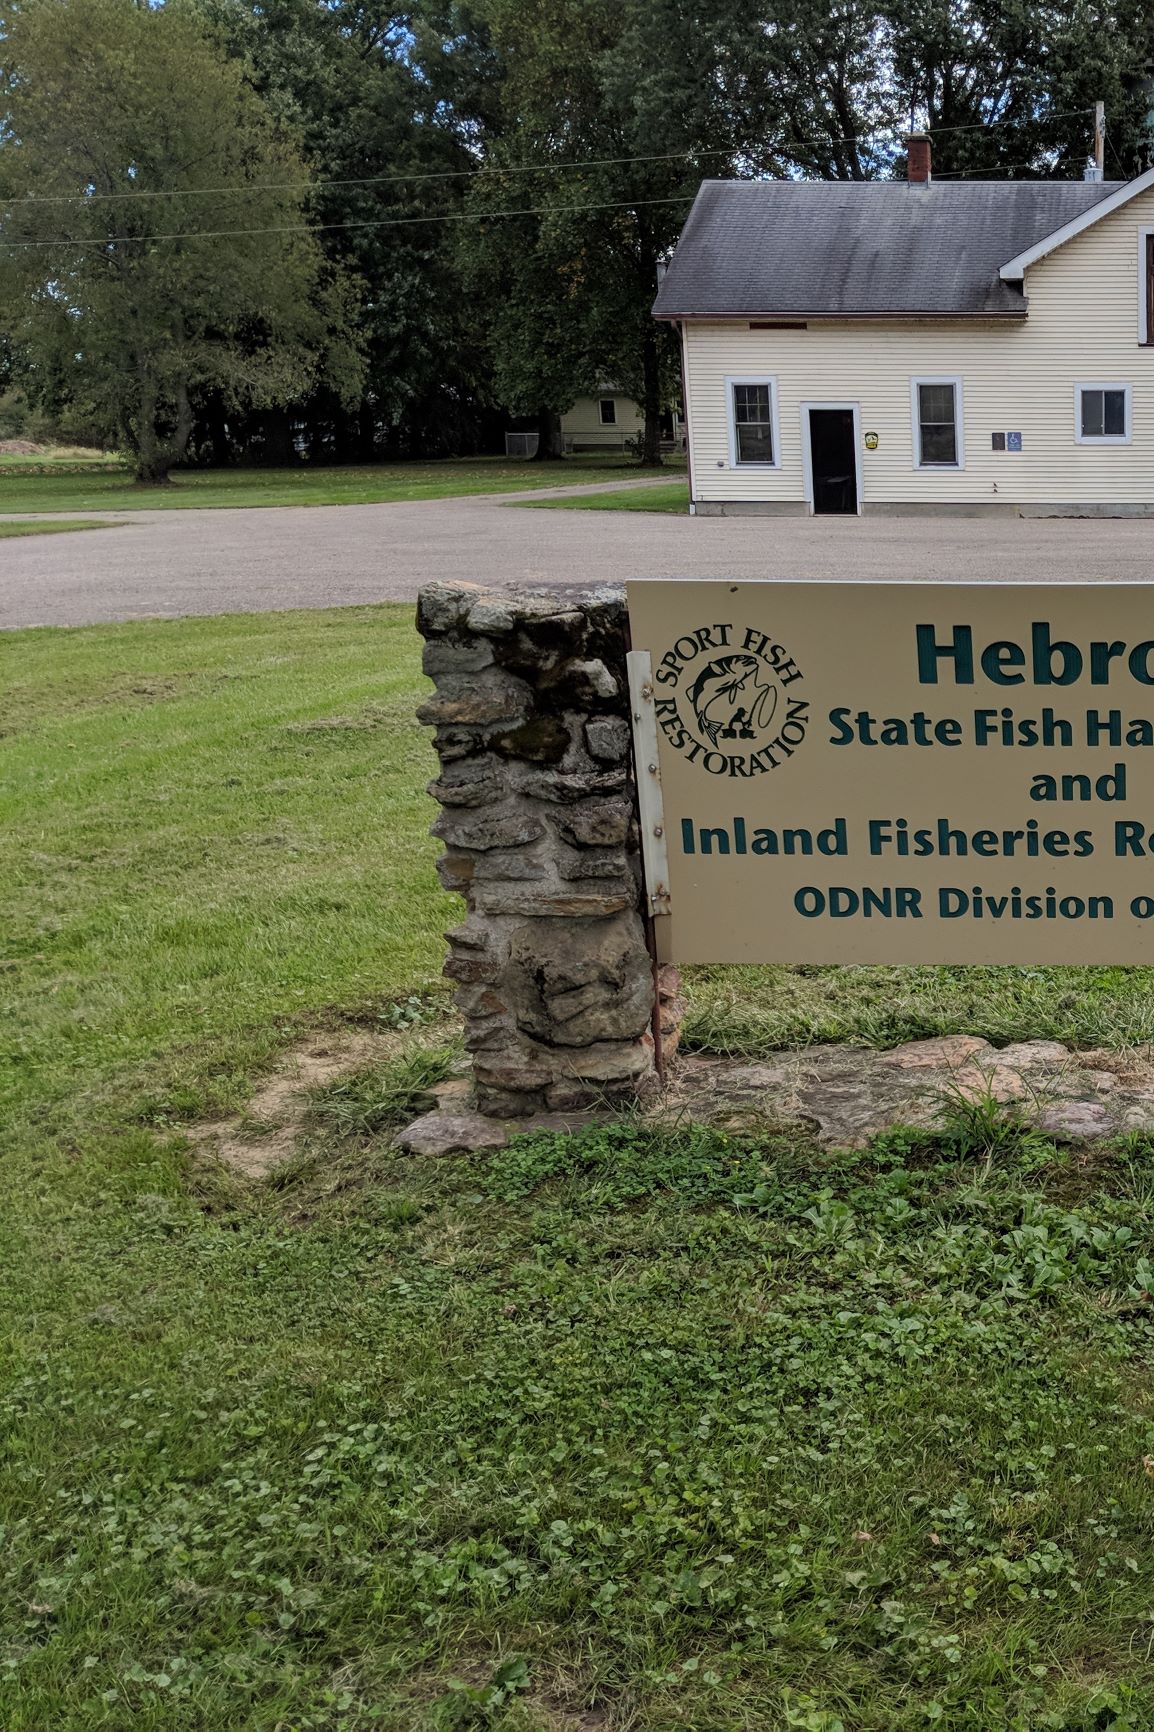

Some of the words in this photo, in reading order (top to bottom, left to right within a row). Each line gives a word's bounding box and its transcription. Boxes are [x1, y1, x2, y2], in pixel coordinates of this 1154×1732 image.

[656, 623, 733, 688] SPORT
[741, 627, 804, 687] FISH
[654, 697, 811, 778] RESTORATION
[828, 707, 963, 747] State
[973, 707, 1073, 747] Fish
[1029, 763, 1127, 802] and
[681, 816, 849, 856] Inland
[868, 817, 1095, 858] Fisheries
[793, 886, 923, 919] ODNR
[938, 885, 1114, 920] Division
